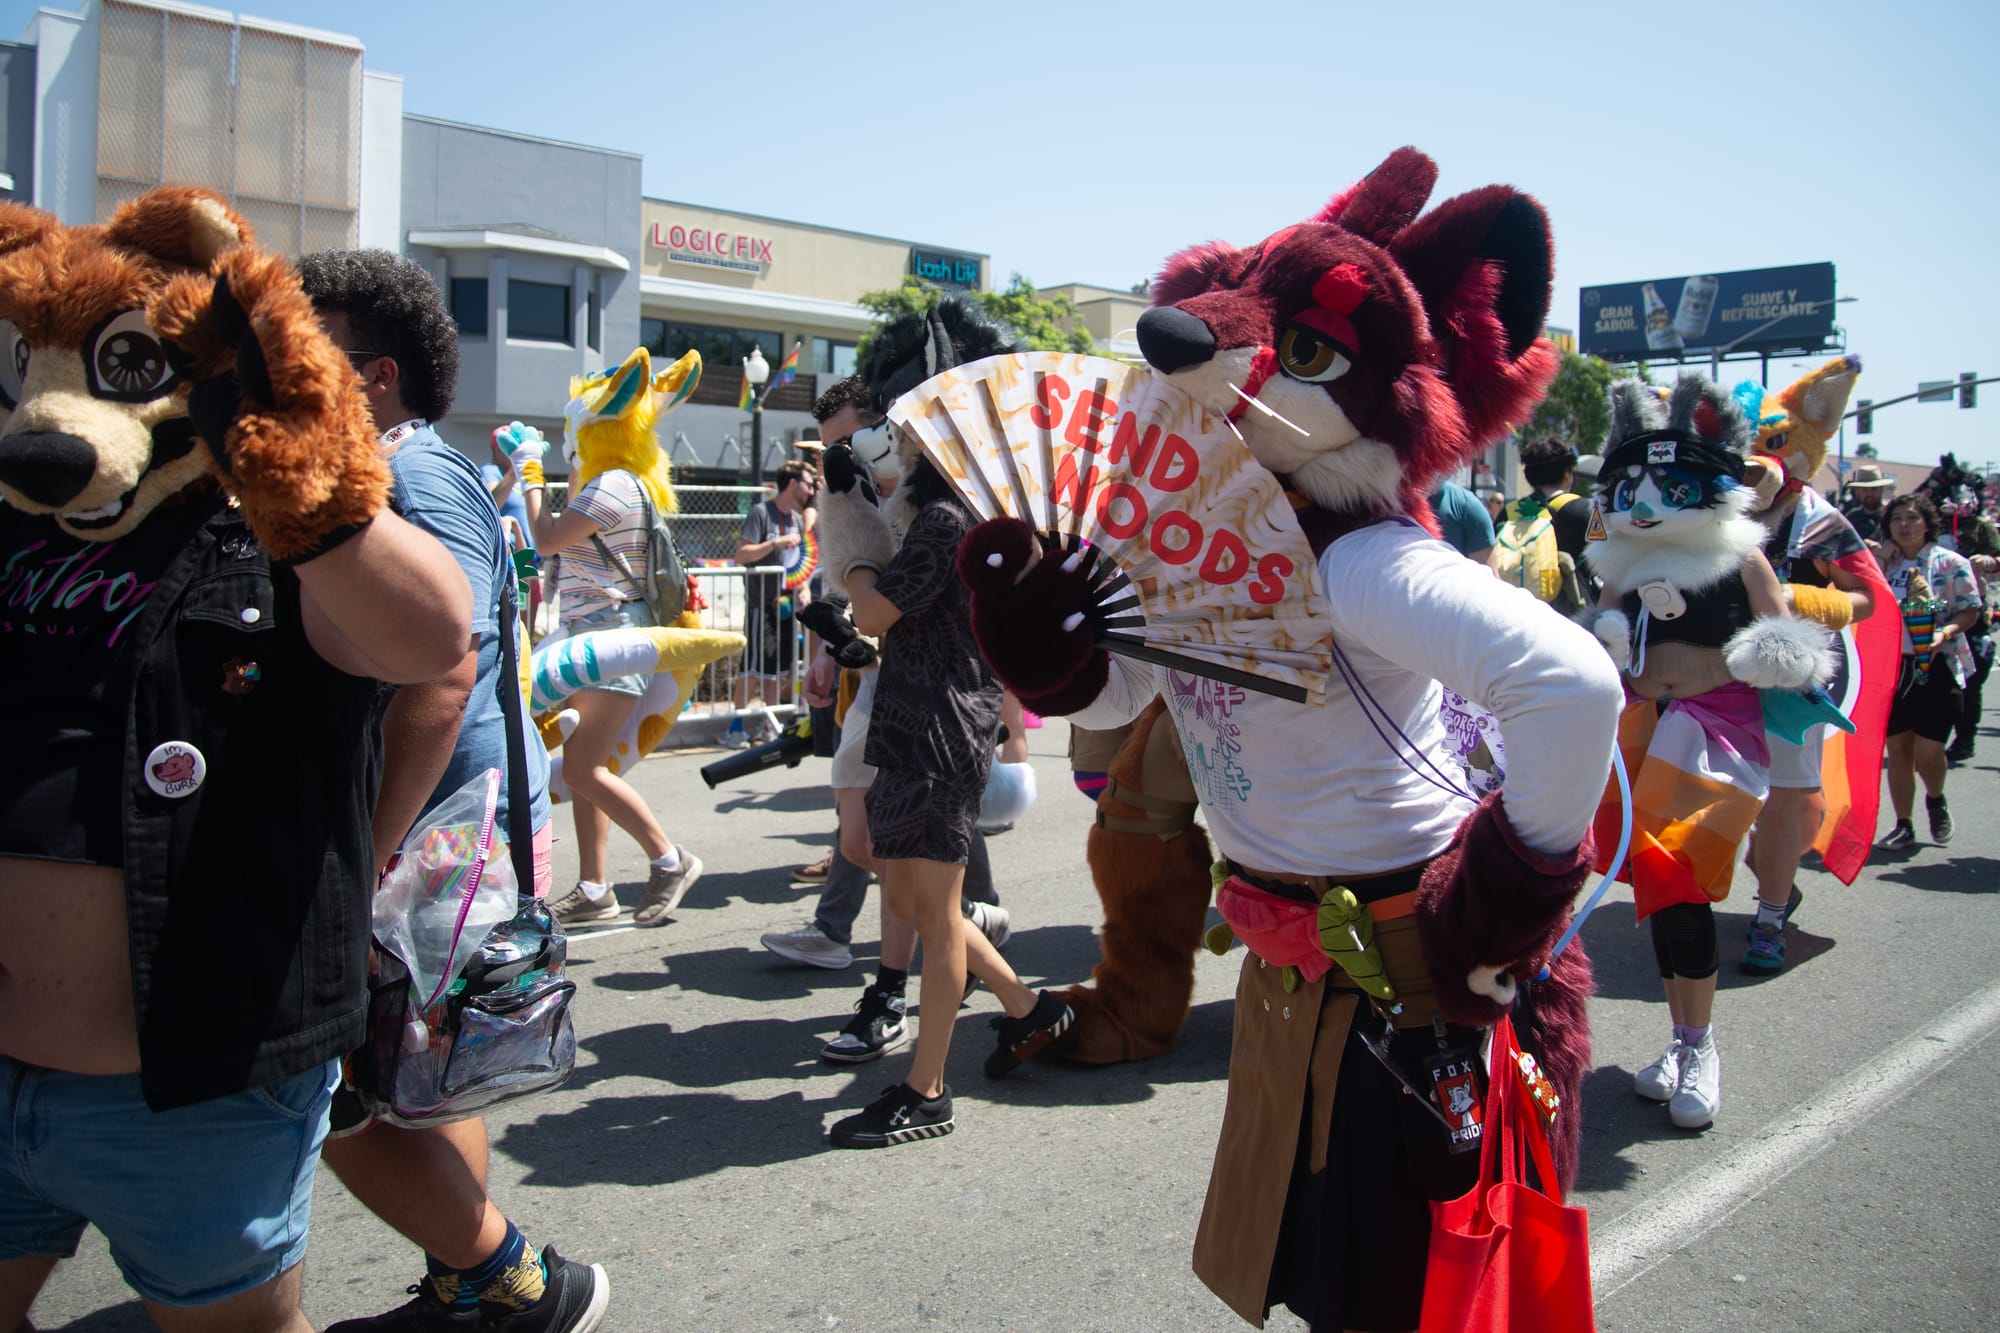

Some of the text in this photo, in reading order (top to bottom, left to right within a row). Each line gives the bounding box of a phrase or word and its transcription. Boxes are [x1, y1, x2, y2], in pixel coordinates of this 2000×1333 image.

[653, 222, 729, 256] LOGIC
[735, 235, 773, 262] FIX
[1600, 305, 1633, 320] GRAN
[1742, 289, 1798, 306] SUAVE Y
[1030, 373, 1200, 493] SEND
[1048, 453, 1294, 605] NOODS
[1431, 1060, 1472, 1082] FOX
